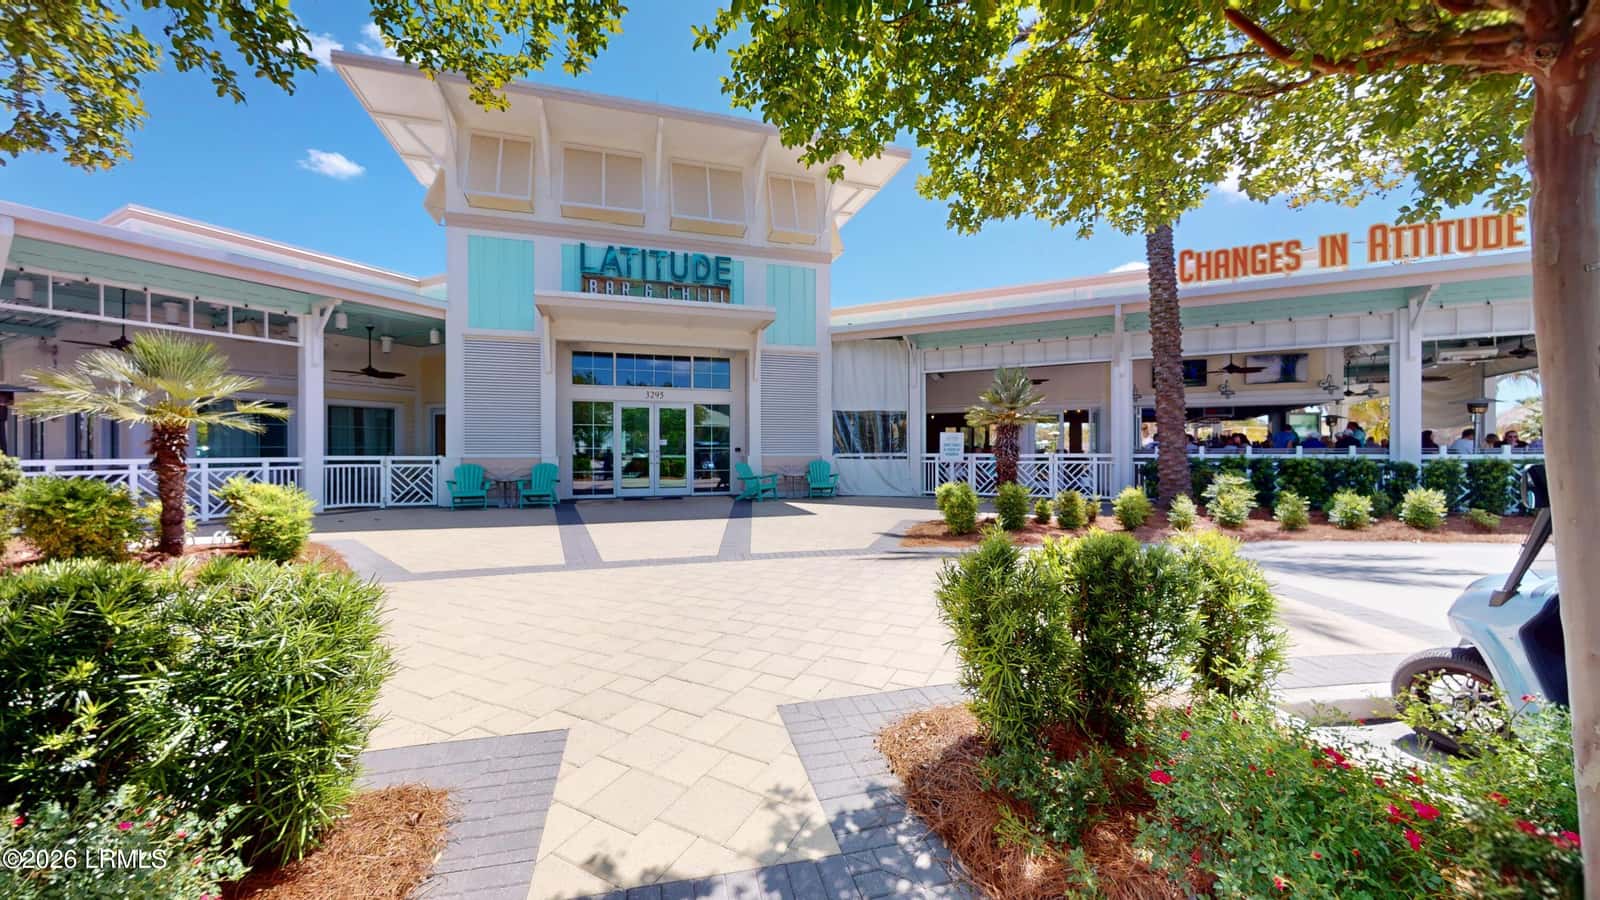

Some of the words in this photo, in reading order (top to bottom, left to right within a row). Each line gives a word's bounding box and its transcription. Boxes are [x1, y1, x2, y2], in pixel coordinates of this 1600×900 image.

[1178, 239, 1302, 284] CHANGES
[1318, 232, 1350, 269] IN
[1367, 213, 1525, 263] ATTITUDE
[579, 243, 732, 284] LATITUDE
[588, 279, 630, 296] BAR
[645, 390, 665, 400] 3295
